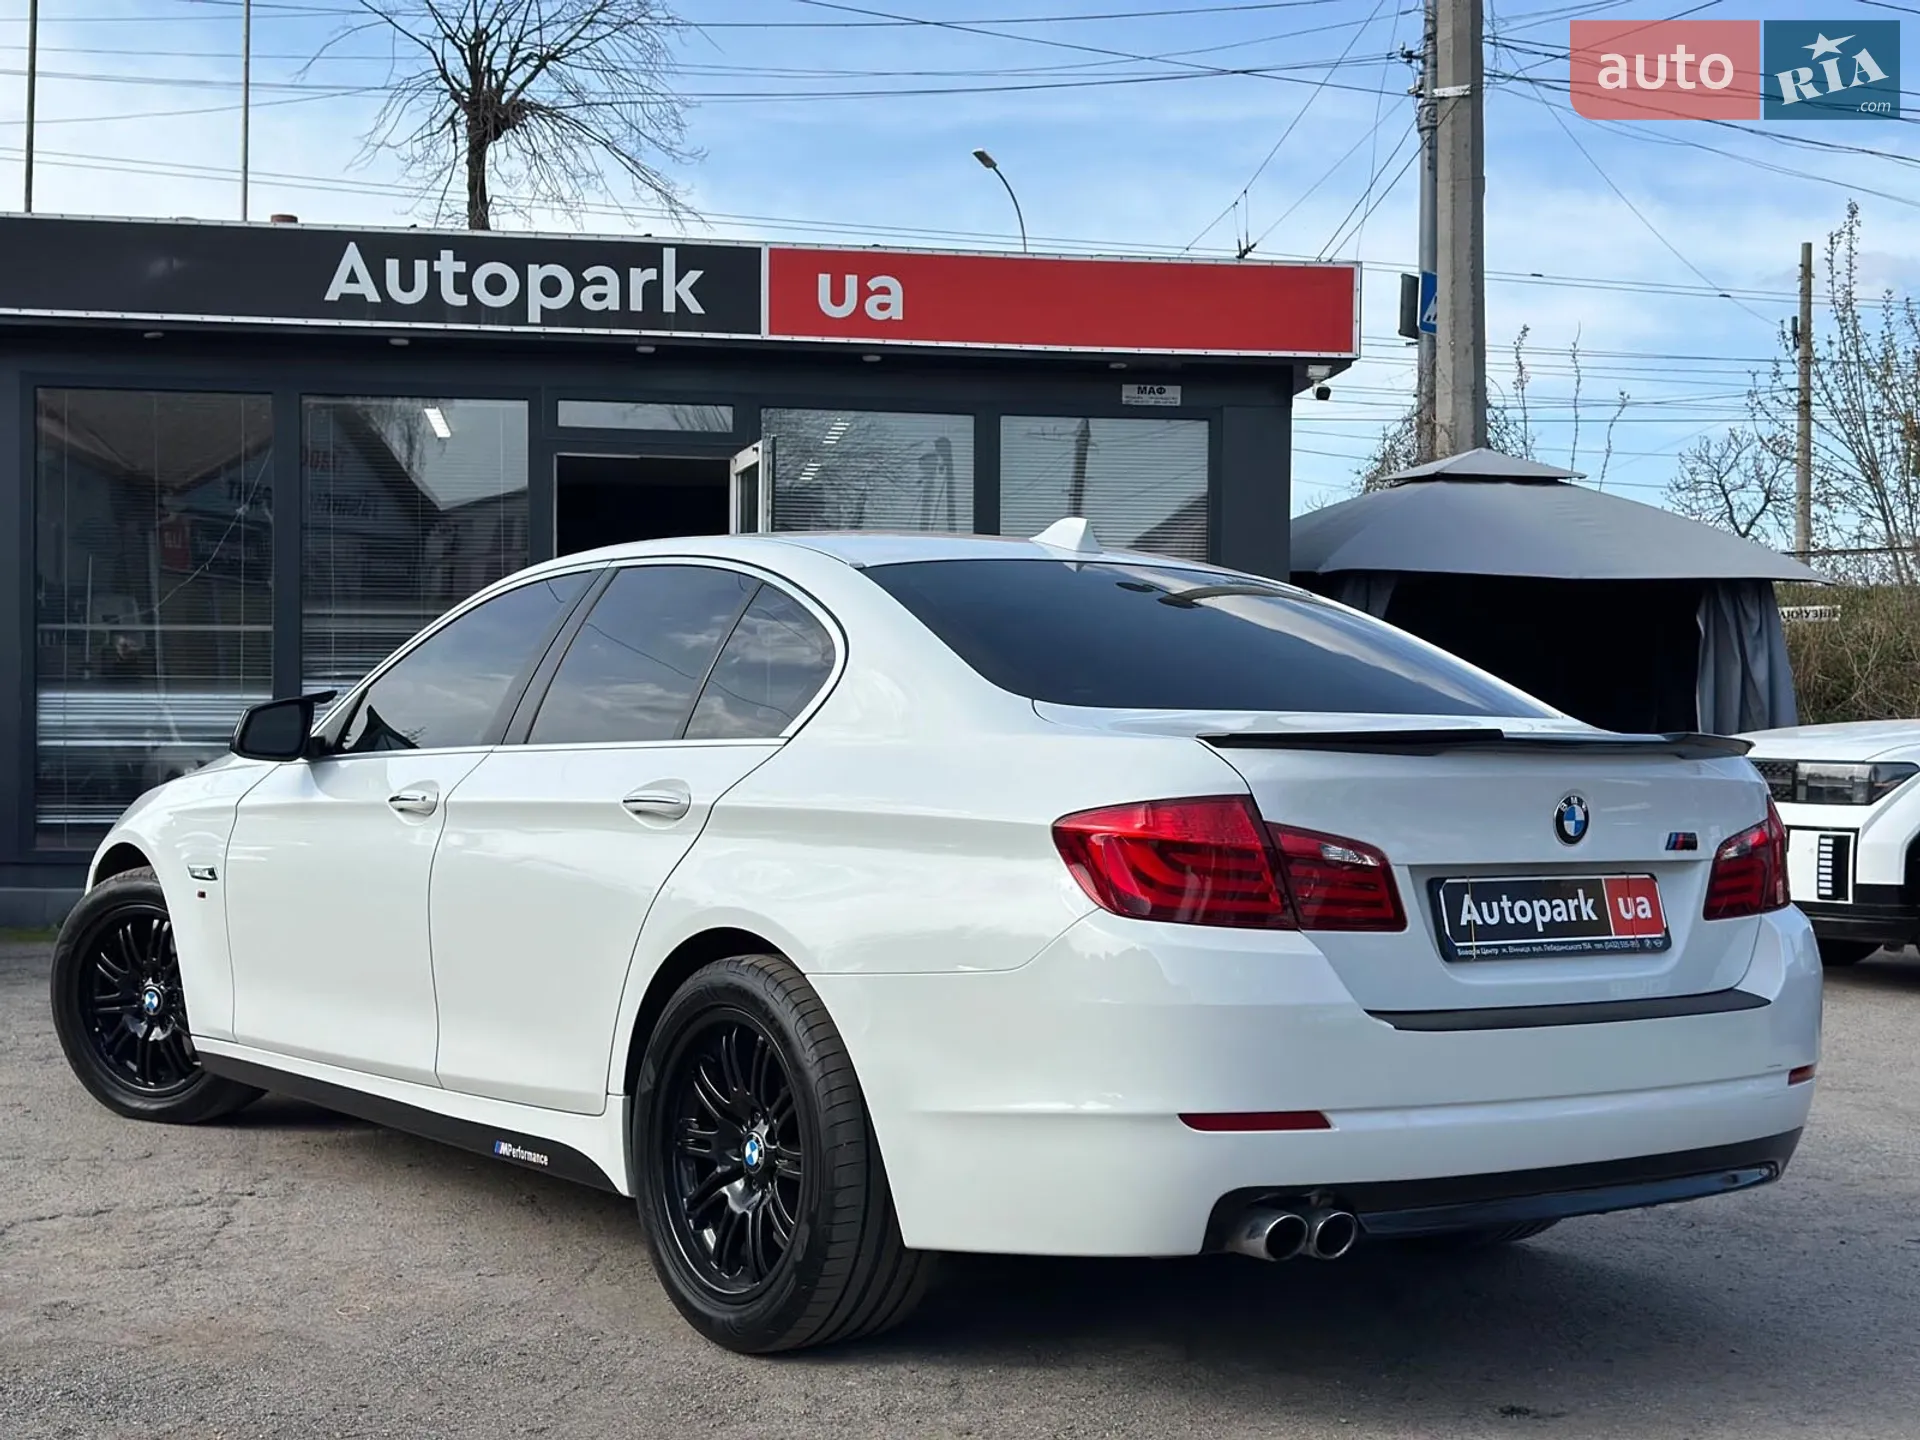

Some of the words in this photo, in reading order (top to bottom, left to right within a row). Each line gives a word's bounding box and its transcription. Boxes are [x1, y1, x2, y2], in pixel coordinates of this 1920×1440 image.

[324, 241, 705, 323] Autopark
[818, 273, 903, 320] ua
[1460, 889, 1598, 932] Autopark
[1618, 896, 1652, 920] ua
